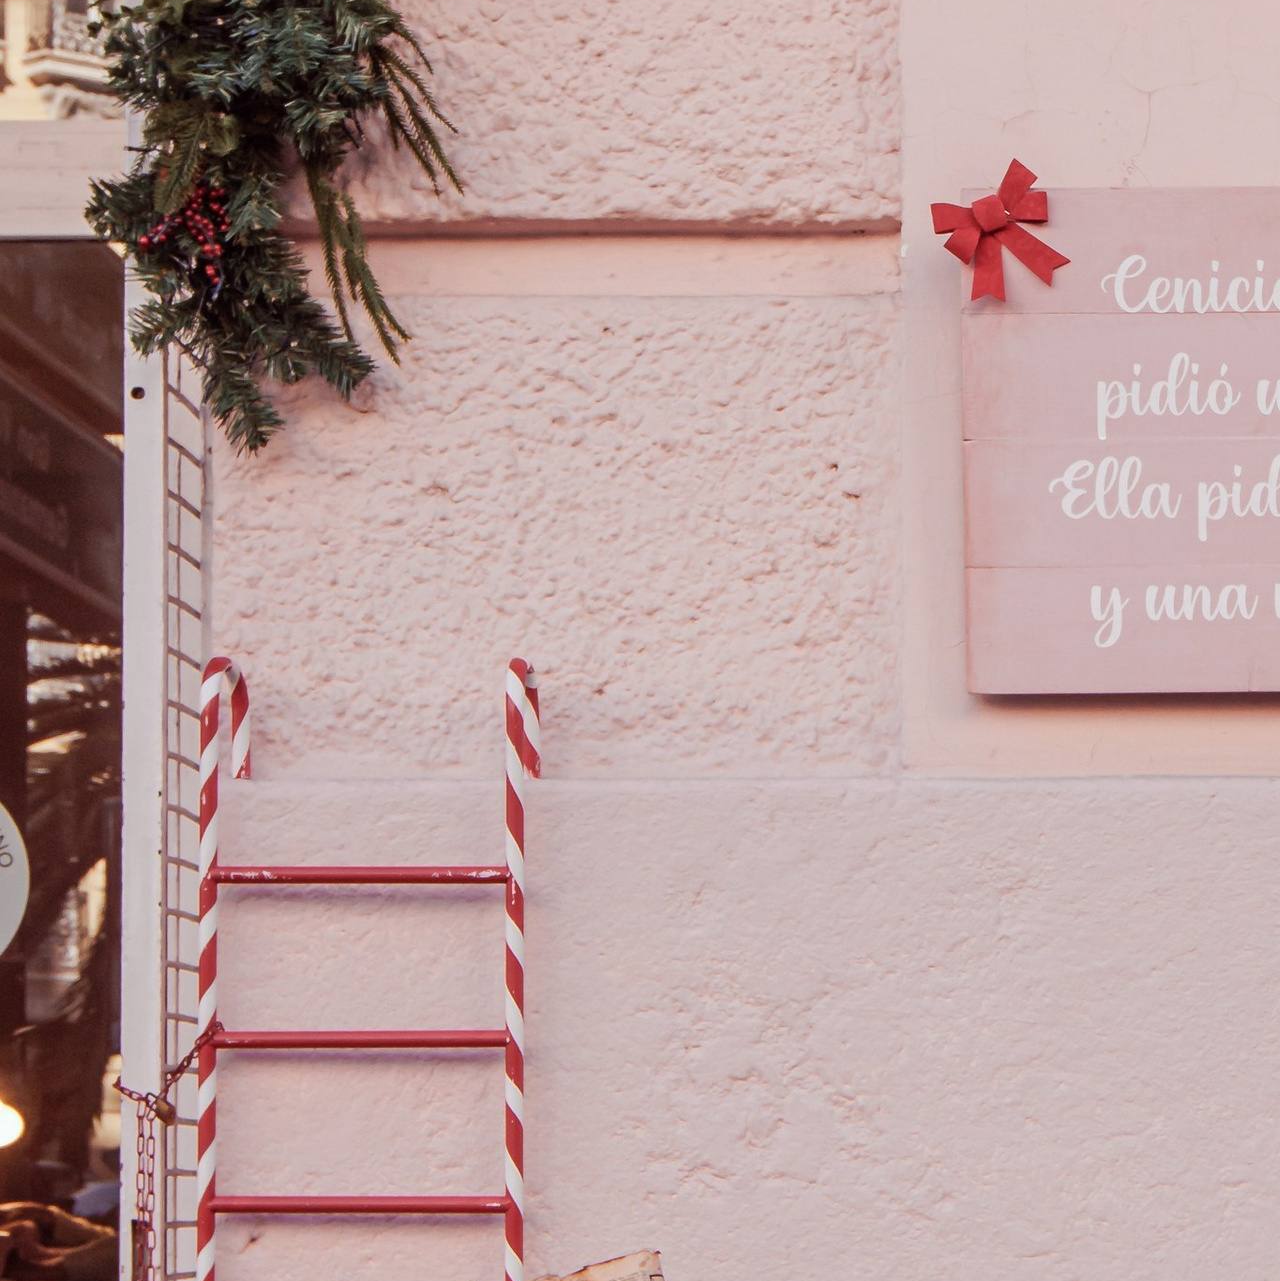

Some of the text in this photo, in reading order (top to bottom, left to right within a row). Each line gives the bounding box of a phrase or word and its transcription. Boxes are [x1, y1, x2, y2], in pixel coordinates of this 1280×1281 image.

[1097, 352, 1242, 441] pidió
[1048, 456, 1180, 519] Ella
[1090, 586, 1131, 648] y
[1145, 584, 1259, 621] una
